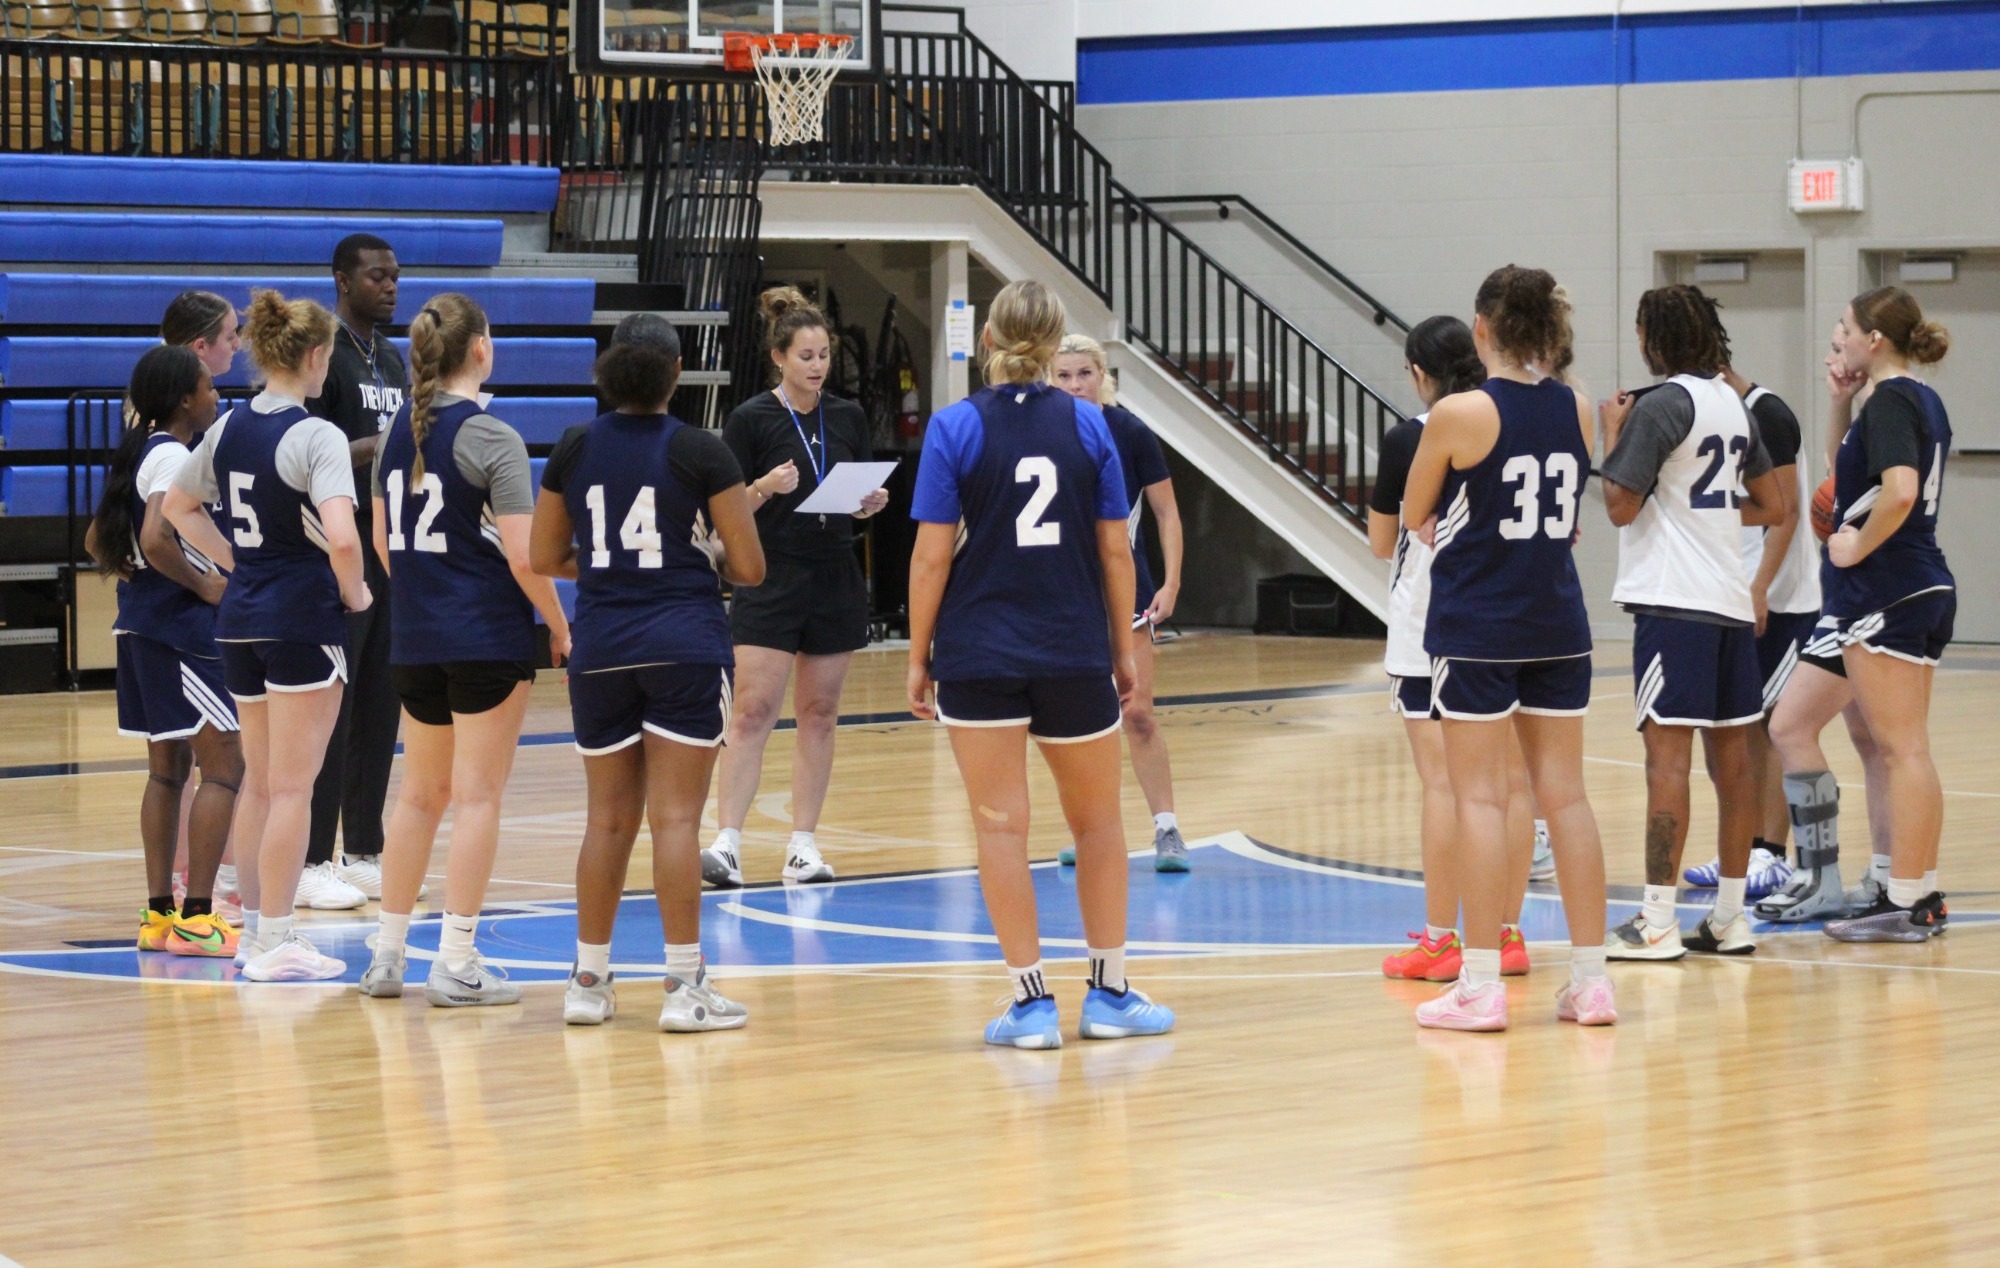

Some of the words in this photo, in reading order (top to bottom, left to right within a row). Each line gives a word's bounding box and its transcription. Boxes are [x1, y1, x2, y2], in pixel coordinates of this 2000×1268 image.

[1803, 170, 1835, 202] EXIT
[229, 471, 264, 548] 5
[387, 469, 448, 553] 12
[585, 485, 663, 569] 14
[1015, 456, 1060, 547] 2
[1499, 452, 1579, 540] 33
